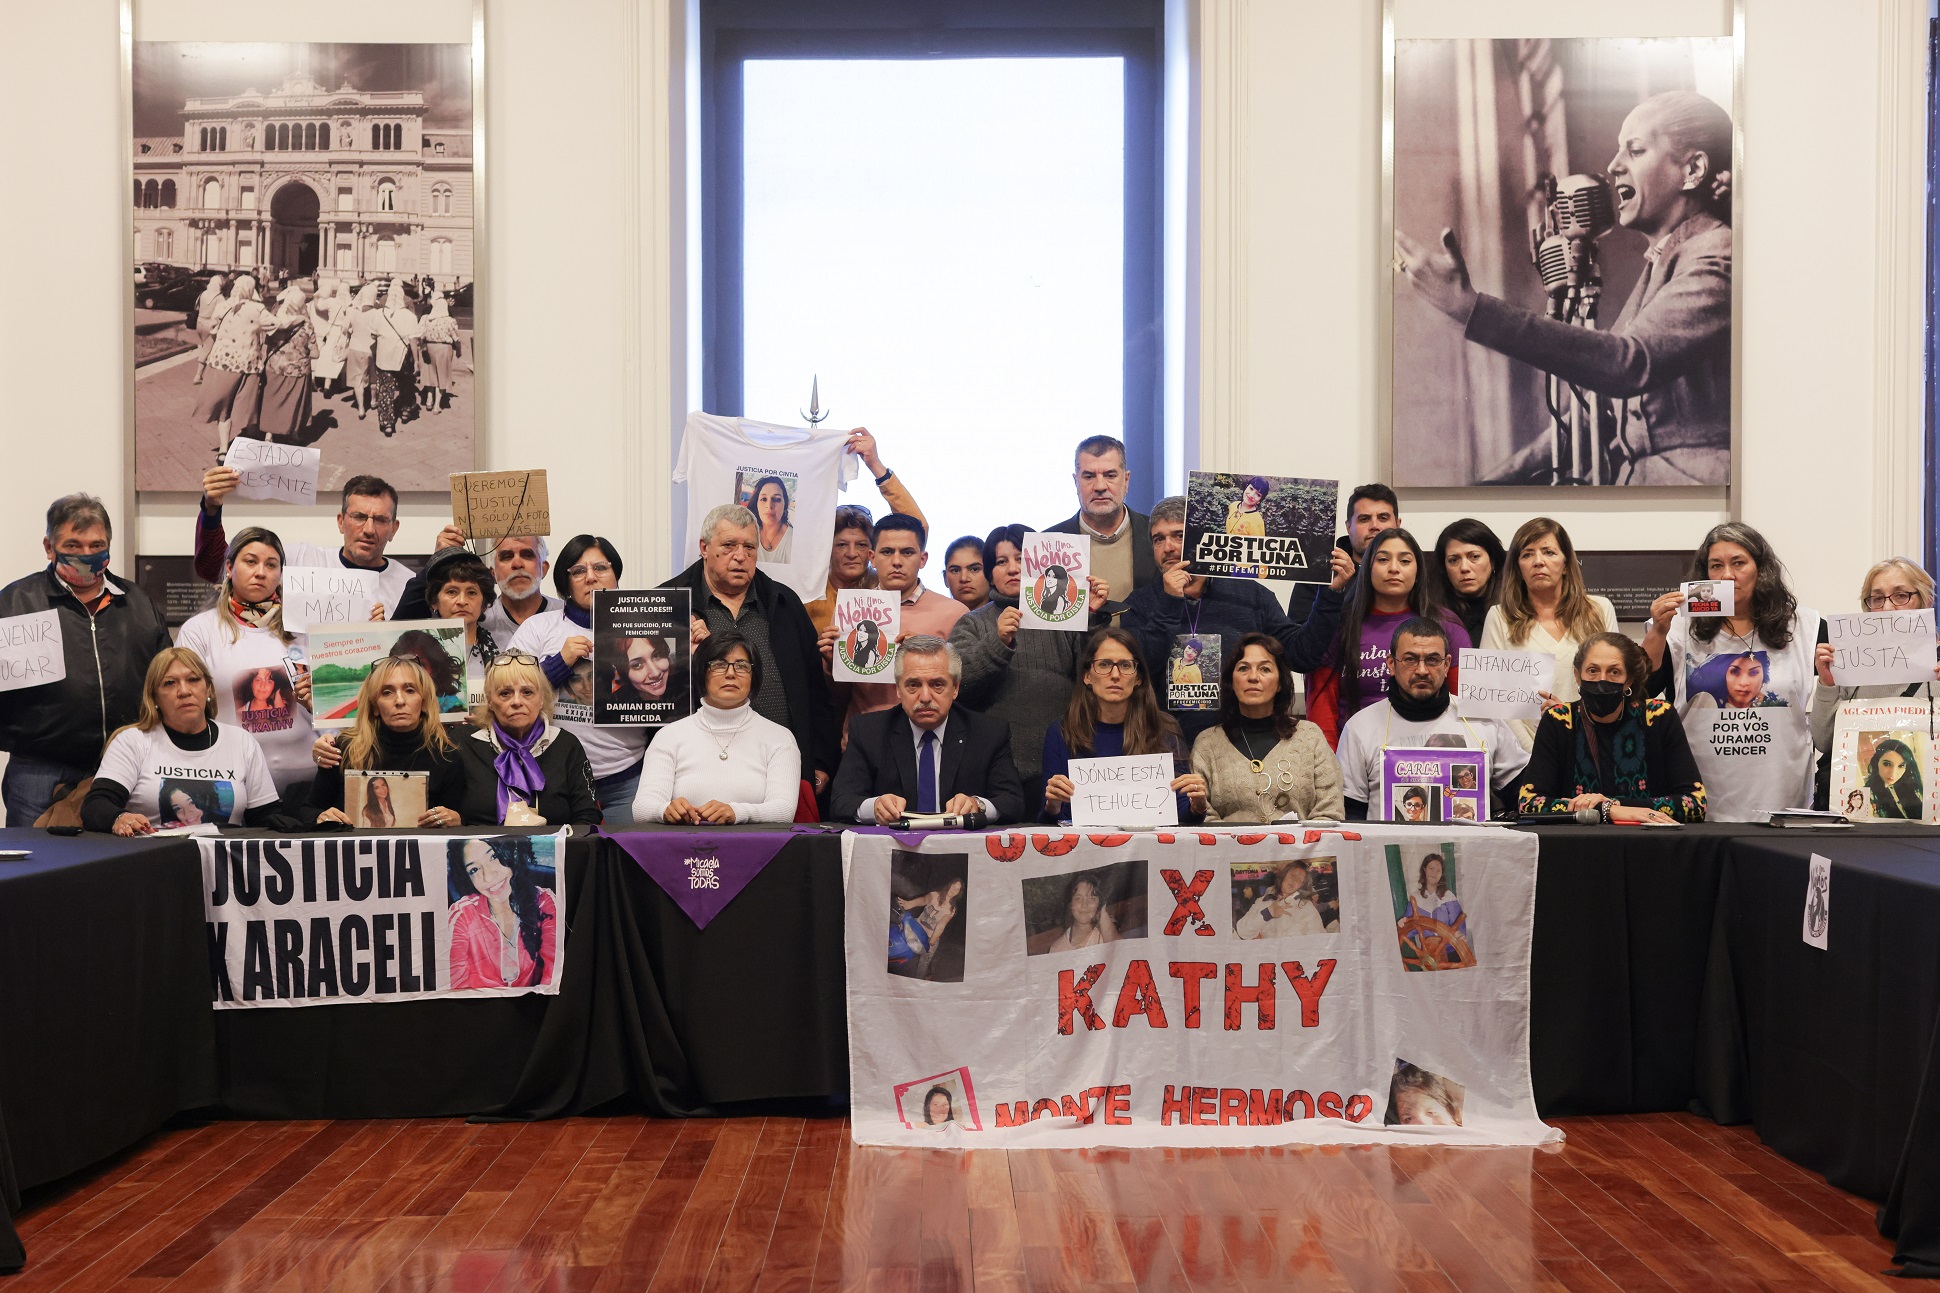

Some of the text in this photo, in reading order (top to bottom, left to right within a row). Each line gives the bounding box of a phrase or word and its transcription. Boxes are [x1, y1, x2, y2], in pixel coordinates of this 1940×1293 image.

[234, 441, 304, 467] ESTADO
[736, 465, 799, 479] JUSTICIA POR CINTIA
[234, 468, 312, 496] RESENTE
[453, 477, 527, 494] QUEREMOS
[482, 509, 510, 523] SÓLO
[526, 509, 550, 521] FOTO
[479, 527, 501, 537] UNA
[1041, 540, 1053, 553] Ni
[1201, 534, 1300, 553] JUSTICIA
[1023, 545, 1083, 578] Menos
[1198, 547, 1306, 567] POR LUNA
[1208, 564, 1287, 577] #FUEFEMICIDIO
[328, 577, 366, 599] UNA
[617, 596, 650, 604] JUSTICIA
[853, 596, 864, 609] Ni
[1026, 590, 1086, 622] JUSTICIA POR GISELA
[837, 601, 893, 632] Menos
[1834, 612, 1928, 639] JUSTICIA
[311, 643, 382, 660] nuestros corazones
[323, 638, 354, 649] Siempre
[839, 645, 895, 675] JUSTICIA POR GISELA
[1461, 654, 1542, 677] INFANCIAS
[1832, 645, 1910, 670] JUSTA
[1187, 690, 1217, 698] LUNA
[1460, 683, 1543, 705] PROTEGIDAS
[241, 707, 290, 722] JUSTICIA
[606, 702, 675, 711] DAMIAN BOETTI
[1720, 708, 1762, 721] LUCÍA,
[252, 718, 294, 733] KATHY
[620, 714, 662, 722] FEMICIDA
[1712, 722, 1769, 733] POR VOS
[1709, 734, 1772, 744] JURAMOS
[1714, 745, 1767, 756] VENCER
[154, 765, 237, 781] JUSTICIA X
[1075, 755, 1166, 786] DÓNDE ESTÁ
[1396, 762, 1441, 777] CARLA
[1083, 786, 1170, 815] TEHUEL?
[683, 856, 720, 869] #Micaela
[211, 839, 426, 907] JUSTICIA
[1159, 868, 1216, 937] X
[242, 911, 437, 1001] ARACELI
[1057, 958, 1338, 1036] KATHY
[994, 1084, 1374, 1128] MONTE HERMOSO
